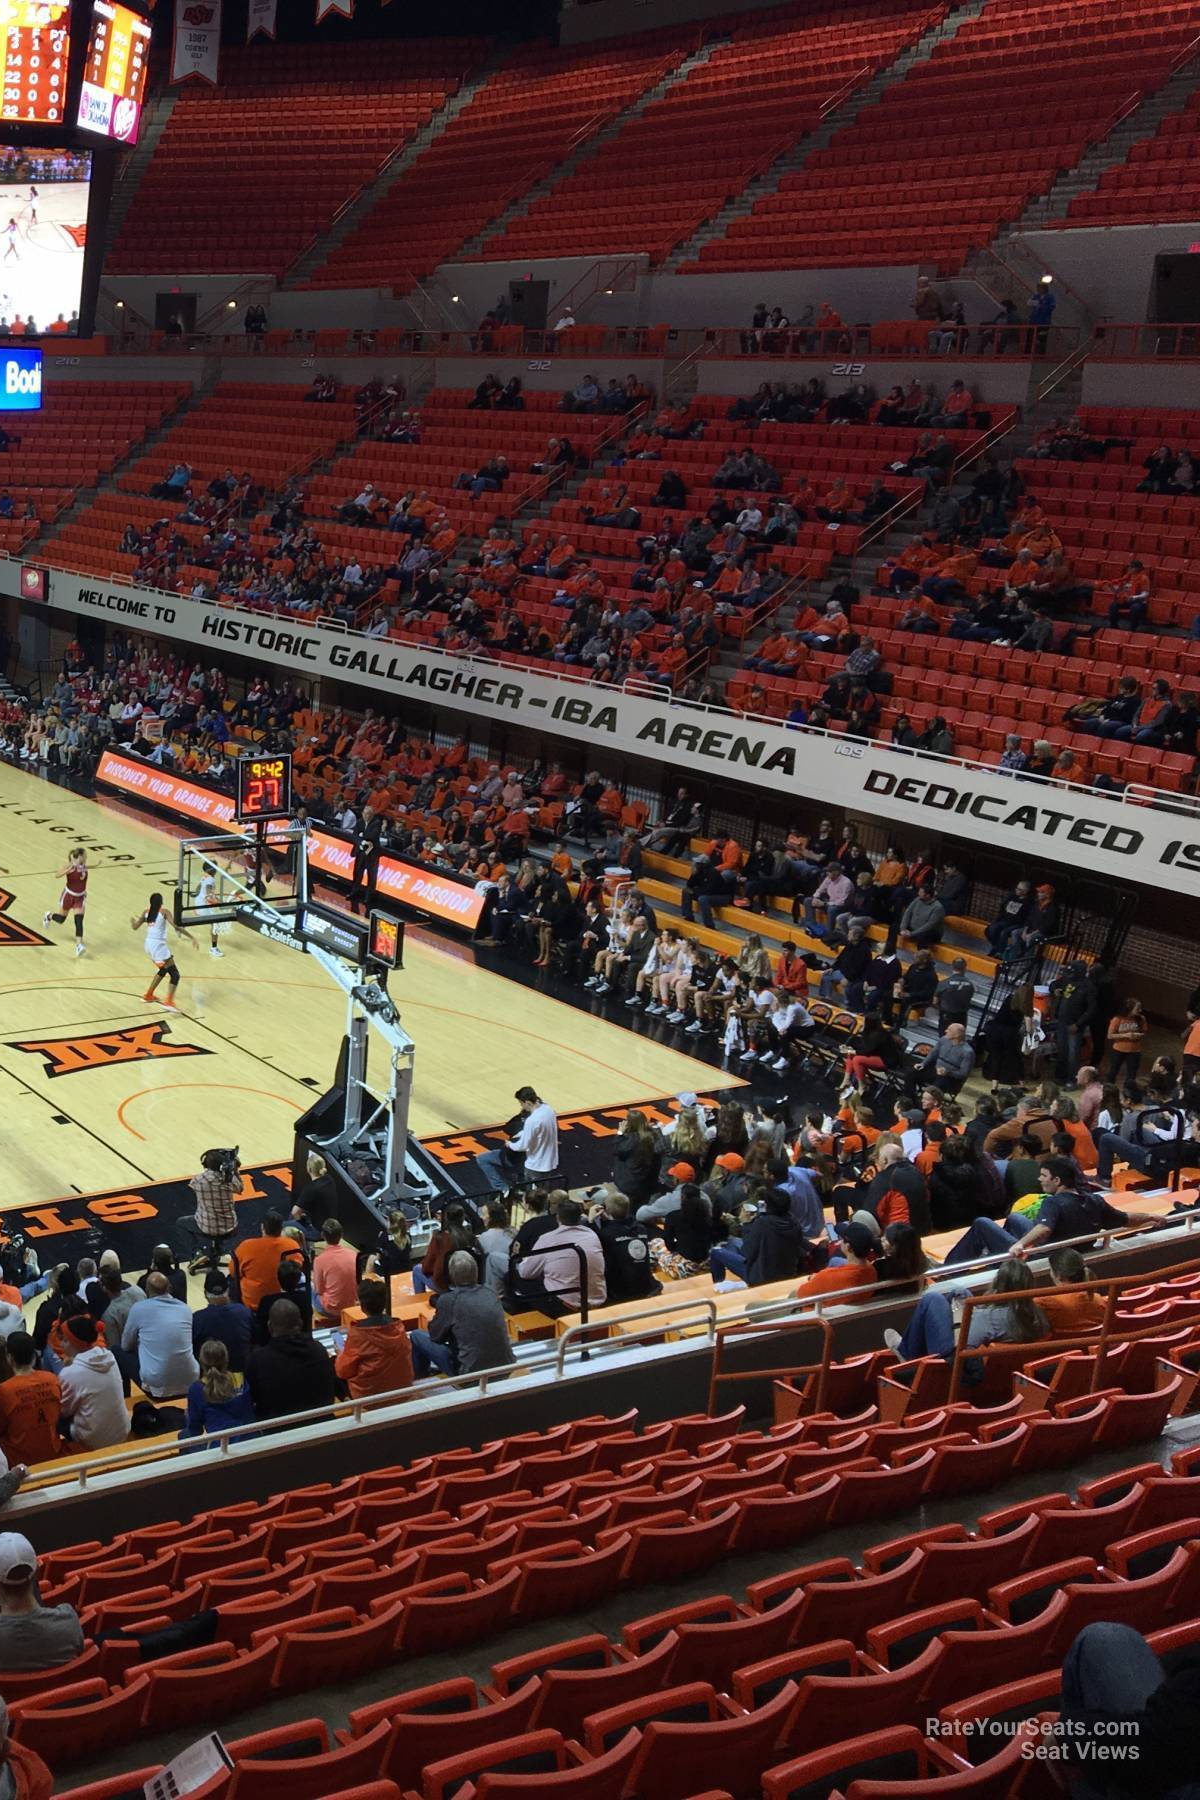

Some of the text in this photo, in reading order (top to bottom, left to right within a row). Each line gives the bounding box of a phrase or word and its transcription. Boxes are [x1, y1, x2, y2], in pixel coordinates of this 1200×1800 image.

[32, 39, 40, 51] 1
[53, 41, 63, 53] 0
[7, 54, 61, 69] 14 0 4
[4, 71, 21, 84] 22
[28, 73, 39, 85] 0
[3, 88, 59, 104] 30 0 0
[3, 104, 19, 117] 32
[47, 108, 58, 120] 0
[55, 356, 81, 366] 210
[527, 359, 553, 371] 212
[832, 363, 866, 376] 213
[78, 588, 176, 624] WELCOME TO
[201, 615, 798, 776] HISTORIC GALLAGHER-IBA ARENA
[833, 743, 865, 759] 109
[252, 760, 284, 779] 9:42
[103, 760, 145, 788] DISCOVER
[147, 776, 173, 798] YOUR
[173, 788, 214, 814] ORANGE
[248, 779, 279, 811] 27
[862, 768, 1145, 856] DEDICATED
[322, 843, 355, 870] YOUR
[409, 879, 474, 914] PASSION
